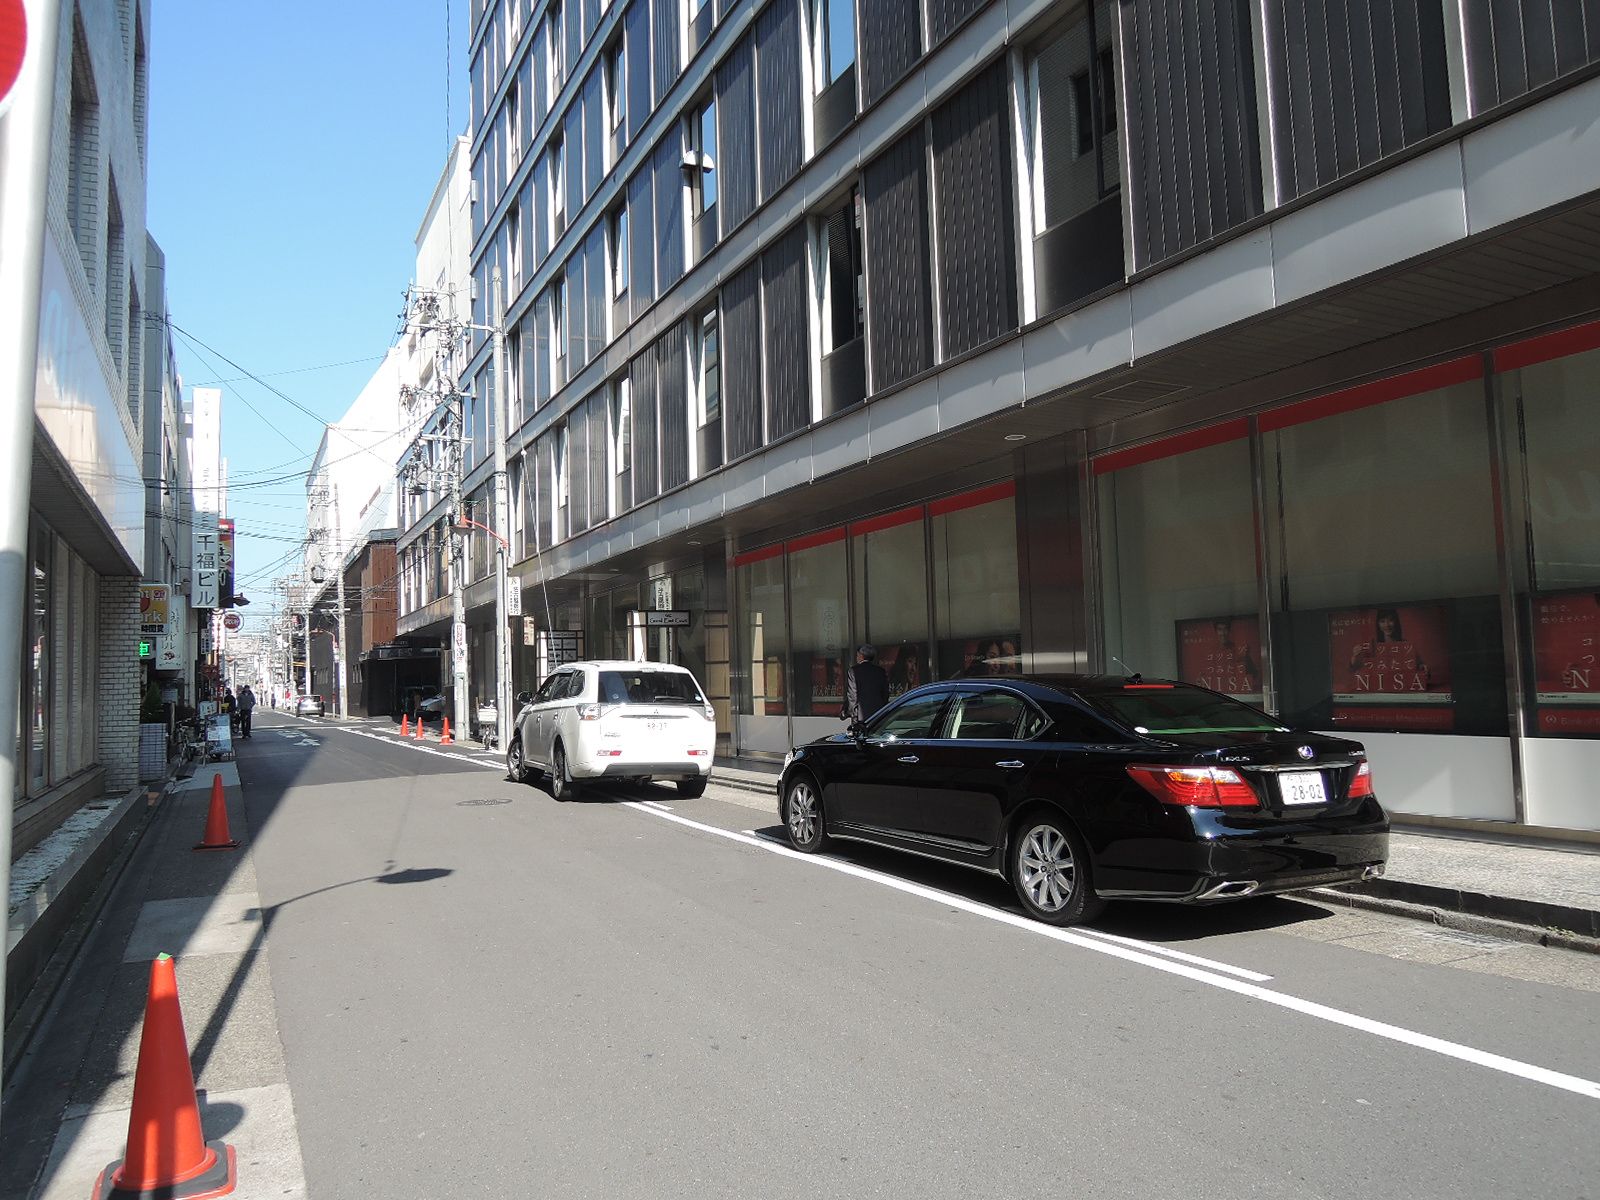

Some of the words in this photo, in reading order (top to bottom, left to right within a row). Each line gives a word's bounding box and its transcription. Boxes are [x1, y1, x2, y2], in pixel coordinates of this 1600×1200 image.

[196, 535, 215, 605] 千福ビル
[1360, 641, 1413, 653] コツコツ
[1364, 658, 1414, 671] つみたて
[1201, 676, 1252, 692] NISA
[1354, 672, 1425, 691] NISA
[1291, 783, 1323, 801] 28-02
